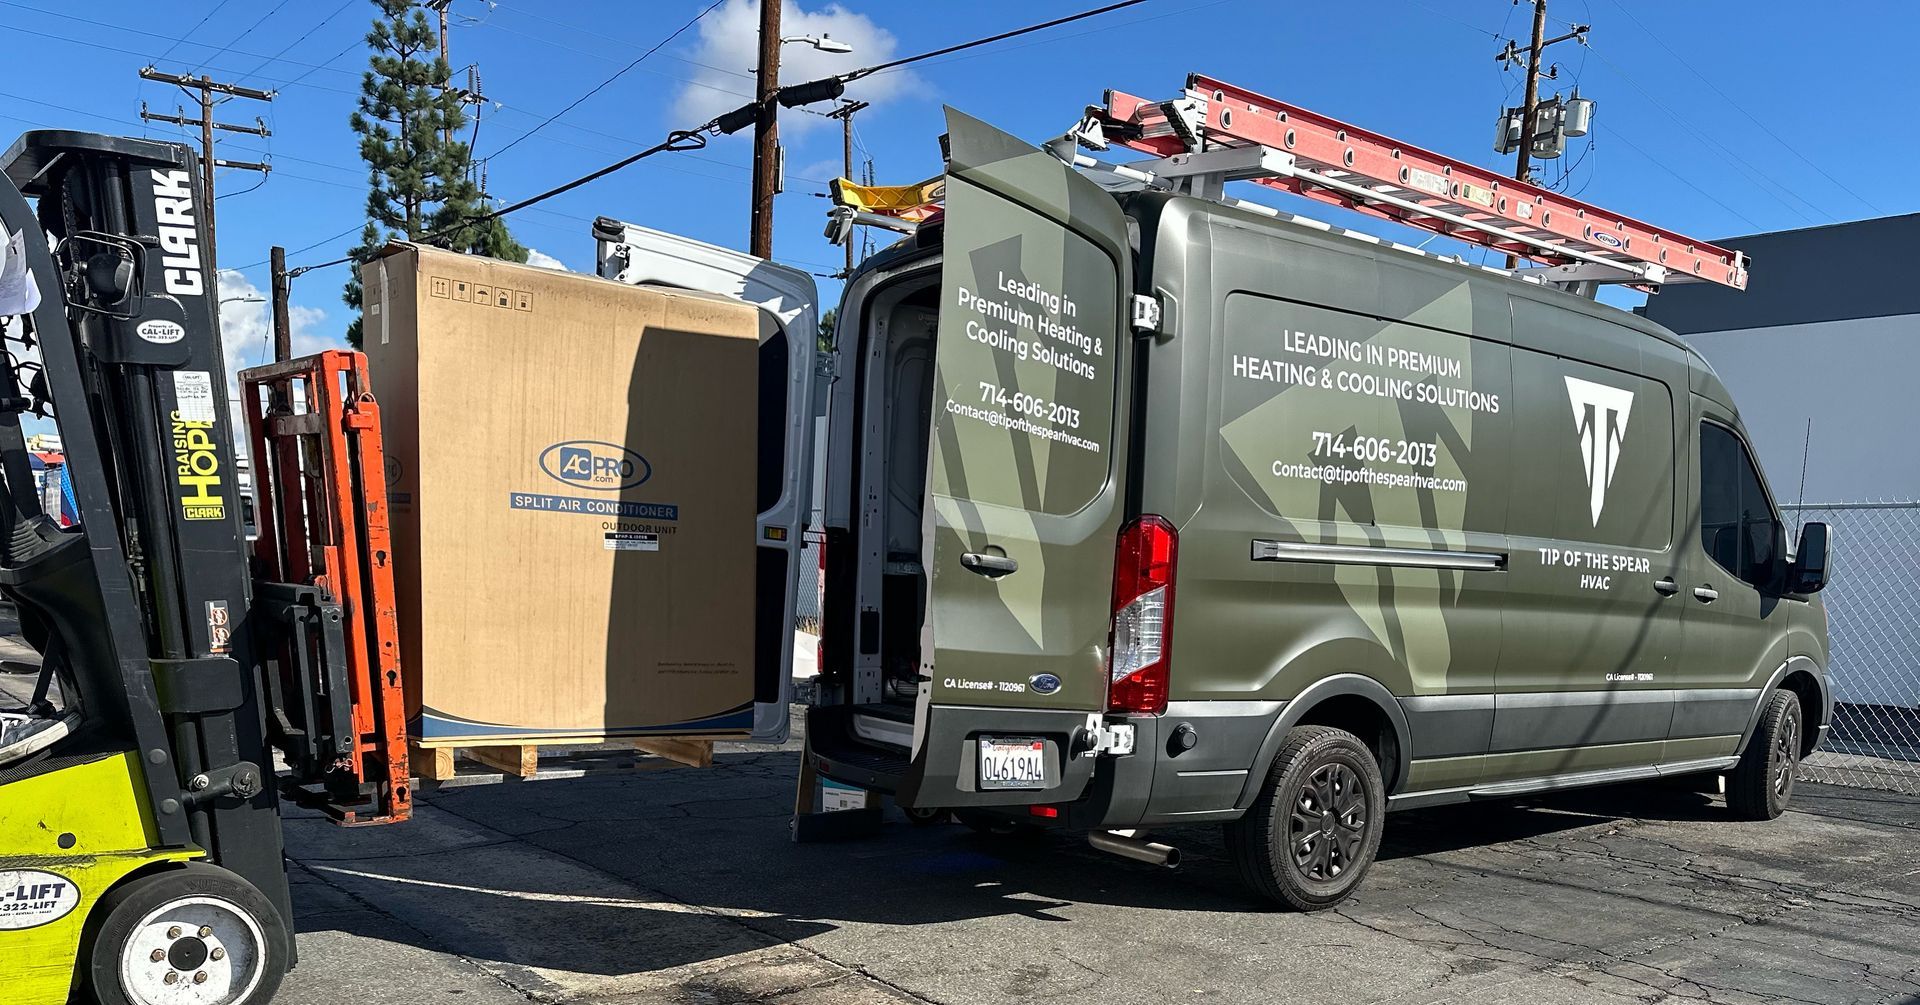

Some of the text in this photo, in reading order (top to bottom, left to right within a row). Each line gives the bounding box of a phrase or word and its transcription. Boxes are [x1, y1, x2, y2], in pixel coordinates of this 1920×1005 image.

[151, 169, 203, 295] CLARK
[998, 271, 1076, 317] Leading in
[958, 287, 1102, 356] Premium Heating &
[966, 320, 1095, 380] Cooling Solutions
[1284, 330, 1461, 378] LEADING IN PREMIUM
[1233, 355, 1500, 414] HEATING & COOLING SOLUTIONS
[980, 382, 1080, 428] 714-606-2013
[171, 410, 192, 475] RAISING
[946, 399, 1100, 453] Contact@tipofthespearhvac.com
[1312, 431, 1436, 467] 714-606-2013
[1272, 460, 1466, 492] Contact@tipofthespearhvac.com
[186, 507, 222, 518] CLARK
[515, 496, 674, 518] SPLIT AIR CONDITIONER
[602, 522, 677, 534] OUTDOOR UNIT
[1539, 548, 1650, 574] TIP OF THE SPEAR
[1580, 574, 1610, 590] HVAC
[944, 678, 956, 688] CA
[958, 679, 993, 690] License#
[1040, 676, 1056, 688] Ford
[984, 757, 1041, 780] 04619A4
